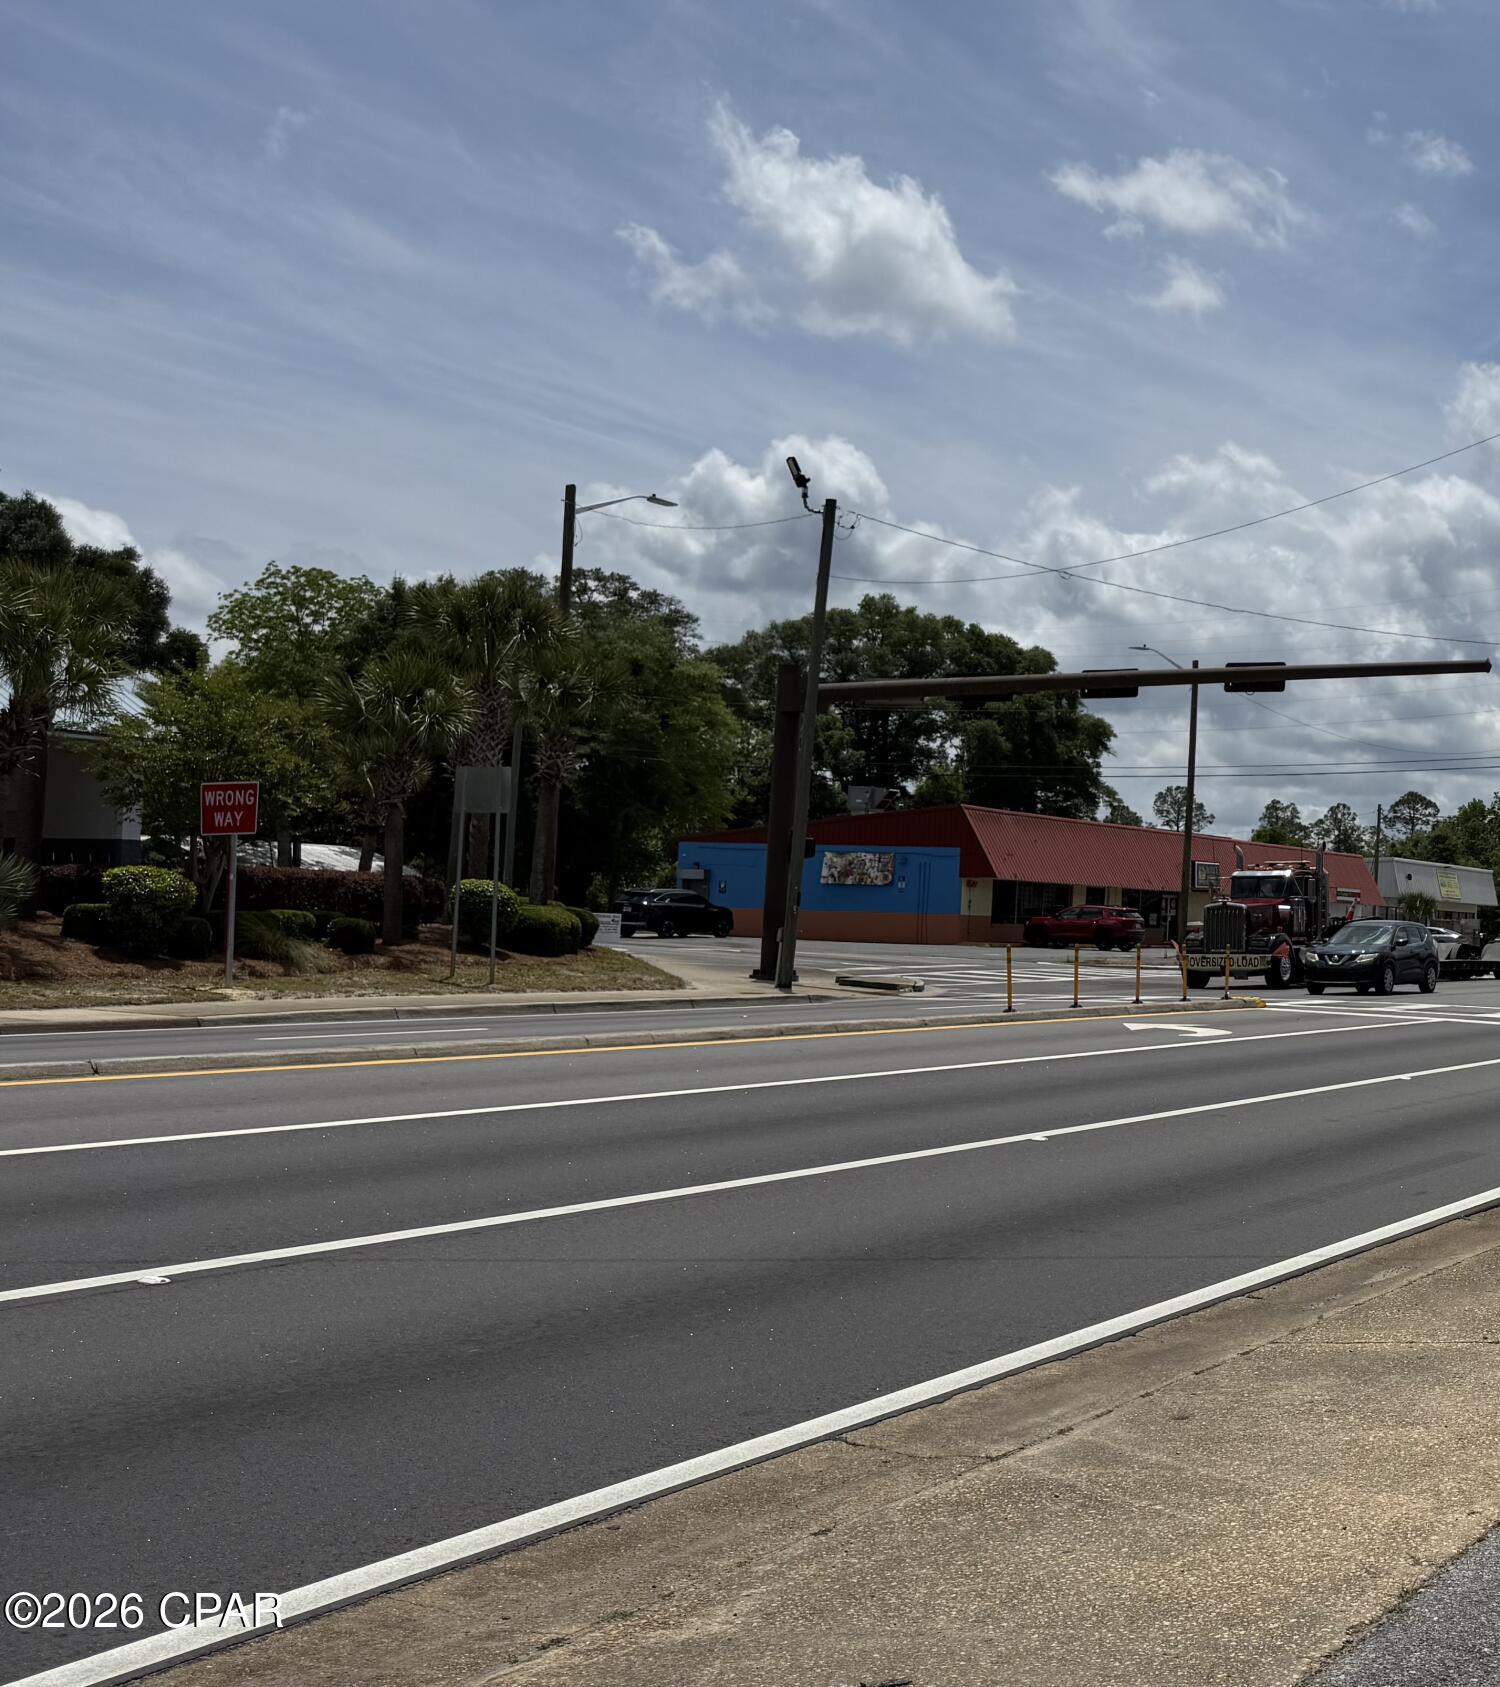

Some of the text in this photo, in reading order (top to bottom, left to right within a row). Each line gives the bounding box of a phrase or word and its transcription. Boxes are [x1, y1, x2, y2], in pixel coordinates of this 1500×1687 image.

[204, 789, 255, 806] WRONG
[214, 811, 244, 827] WAY
[1189, 956, 1260, 968] OVERSIZD LOAD
